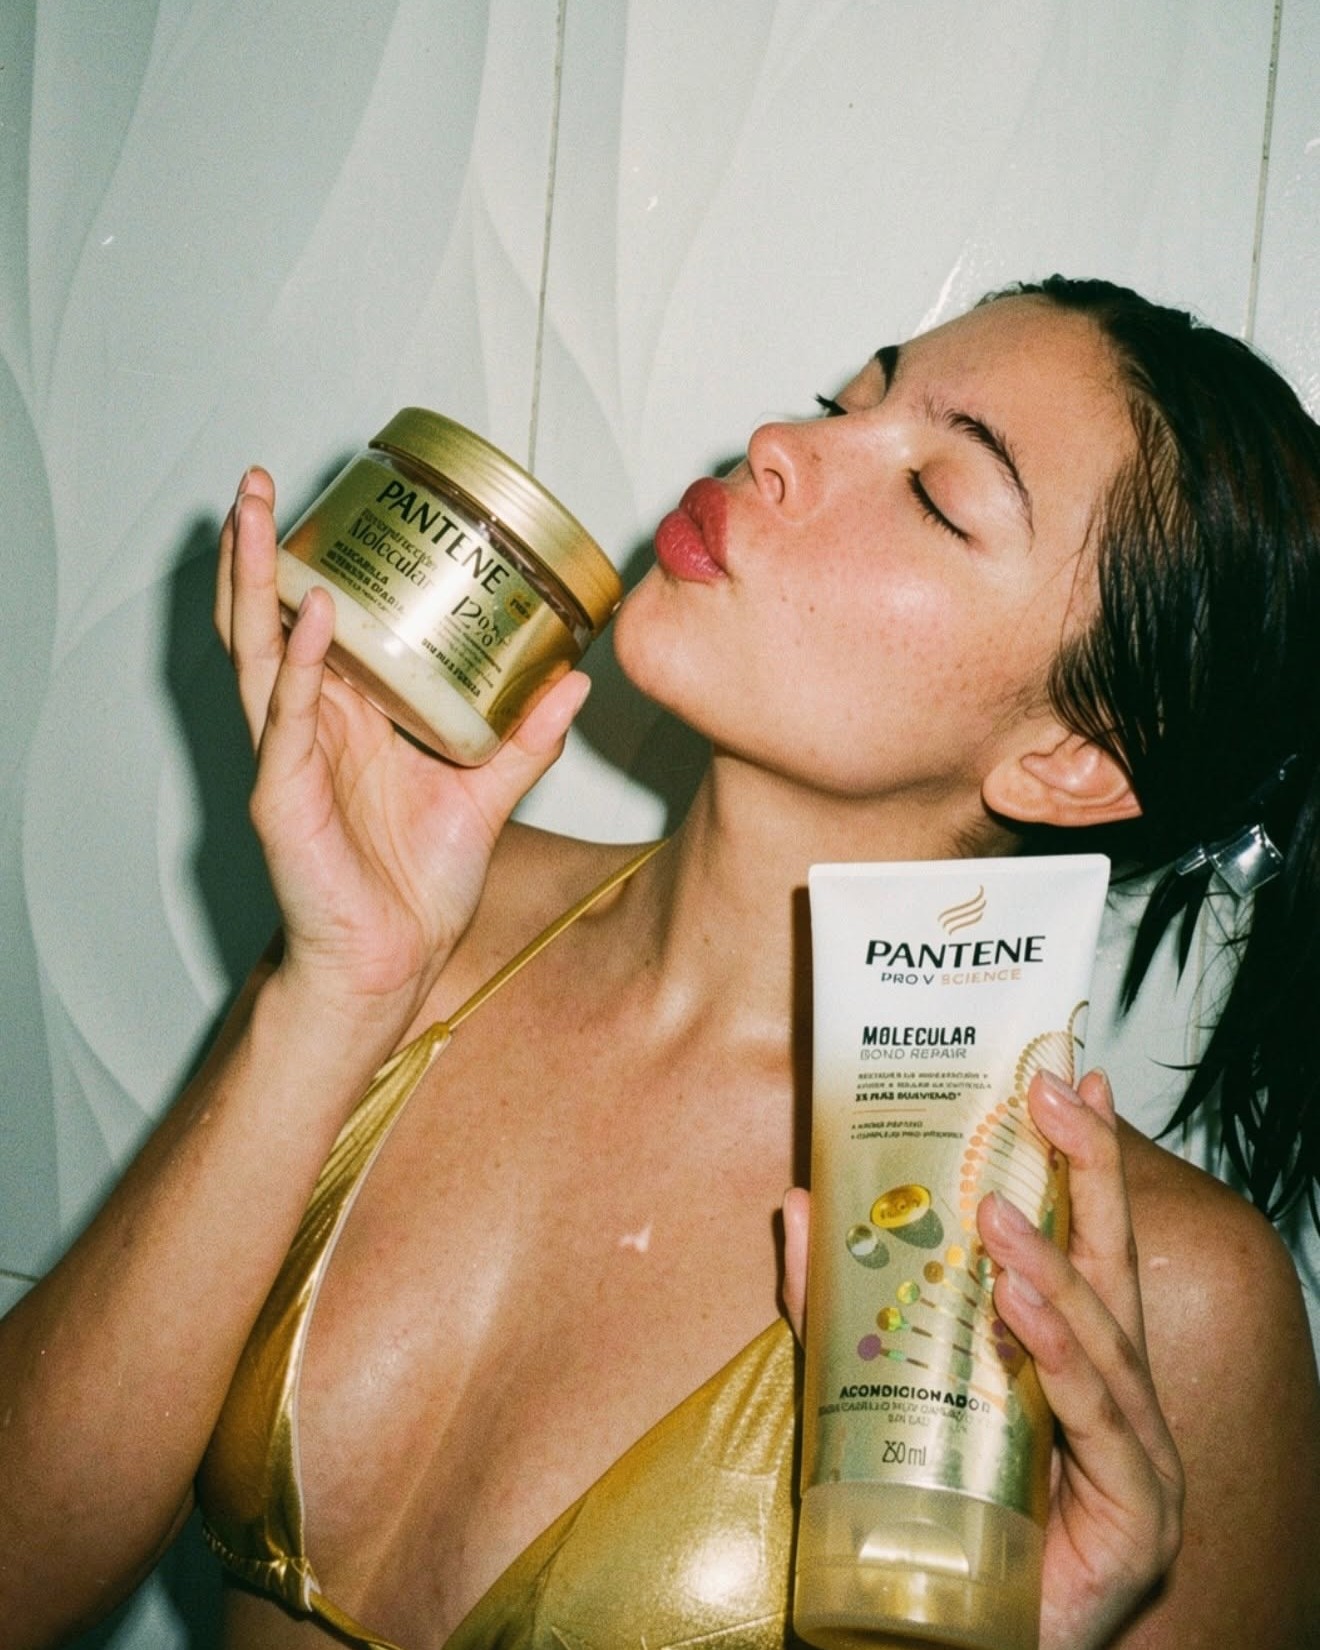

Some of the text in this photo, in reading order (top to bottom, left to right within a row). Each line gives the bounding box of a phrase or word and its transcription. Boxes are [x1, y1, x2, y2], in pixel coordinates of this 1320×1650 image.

[376, 480, 509, 595] PANTENE
[865, 935, 1046, 969] PANTENE
[881, 968, 1022, 985] PRO V SCIENCE
[862, 1026, 976, 1046] MOLECULAR
[860, 1047, 967, 1060] BOND REPAIR
[839, 1385, 991, 1413] ACONDICIONADOR
